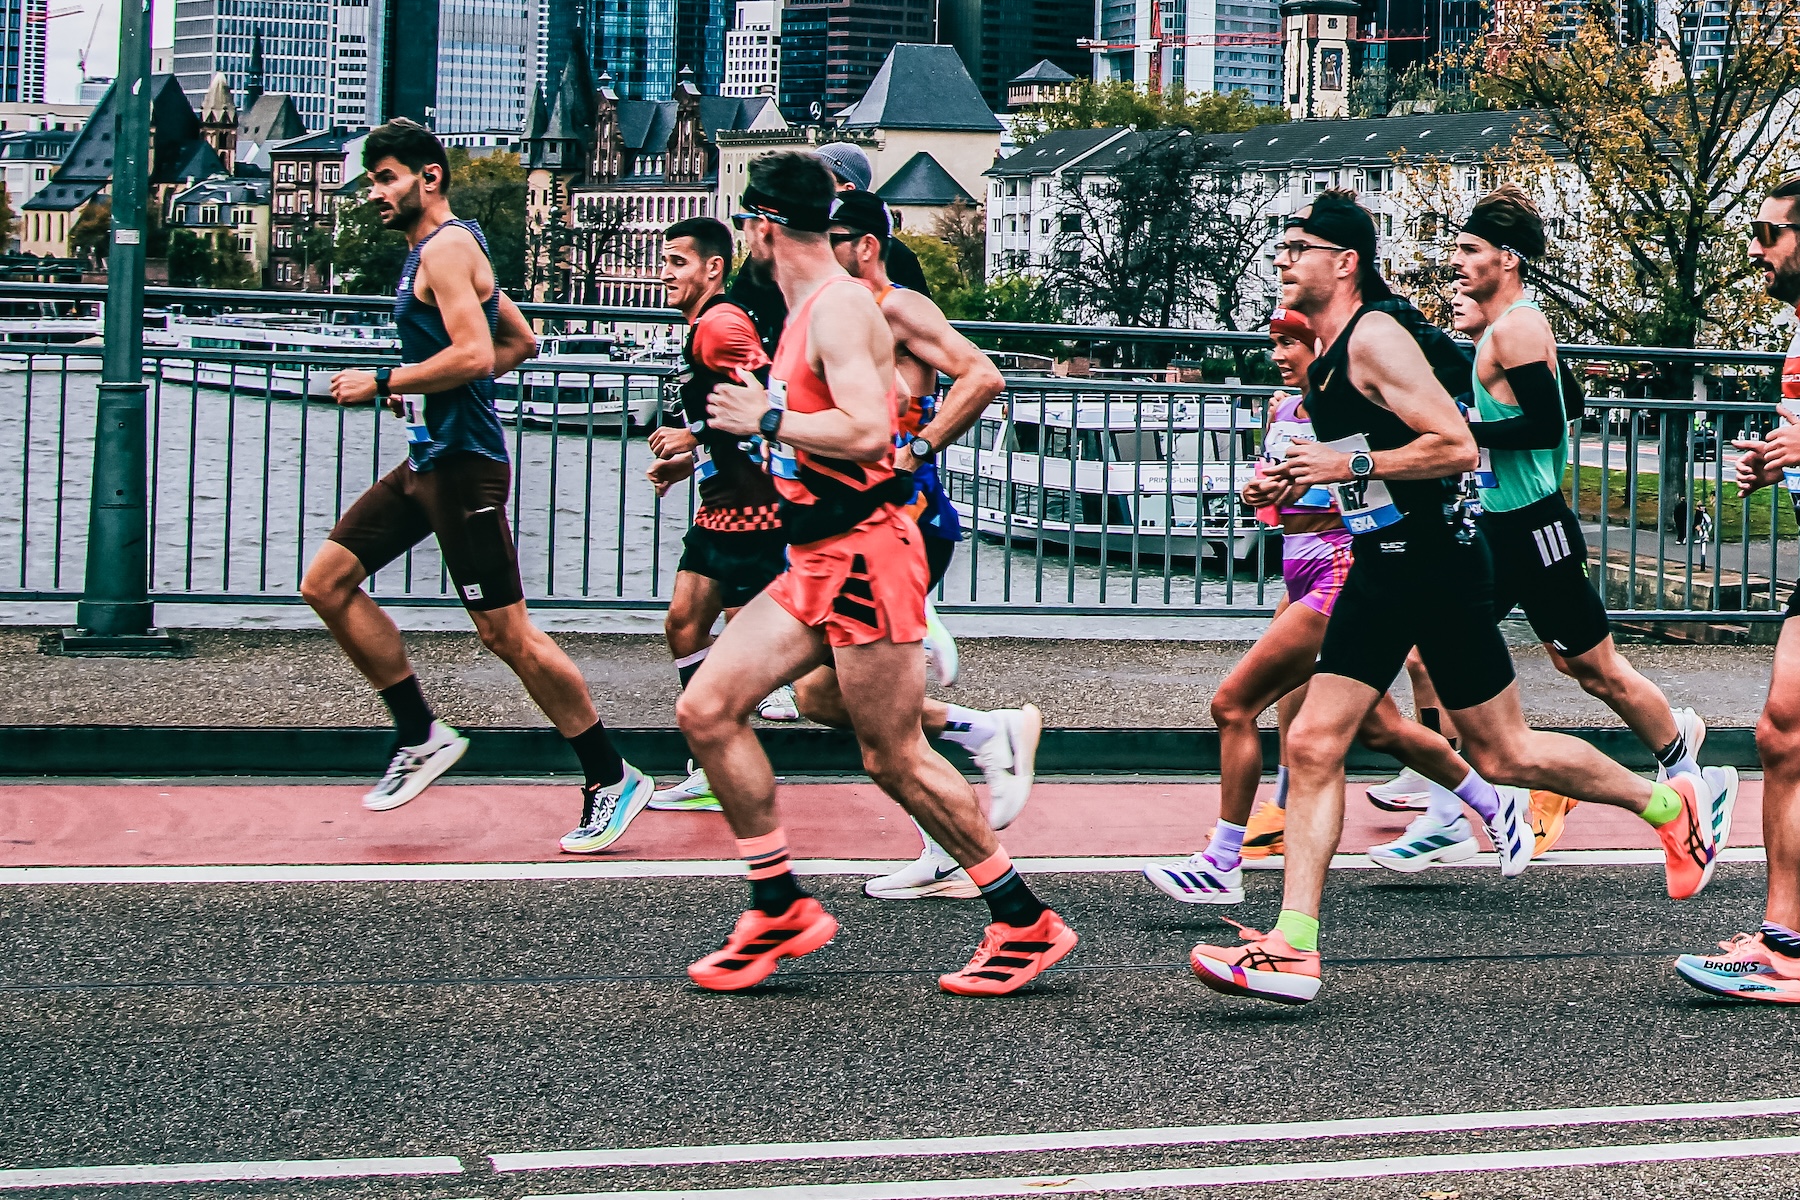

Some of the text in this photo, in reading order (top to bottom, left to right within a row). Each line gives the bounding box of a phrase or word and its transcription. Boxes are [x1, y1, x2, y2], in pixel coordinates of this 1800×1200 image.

[1148, 476, 1198, 484] PRIMS-LINIE
[597, 793, 621, 832] HOKA
[1703, 960, 1760, 973] BROOKS
